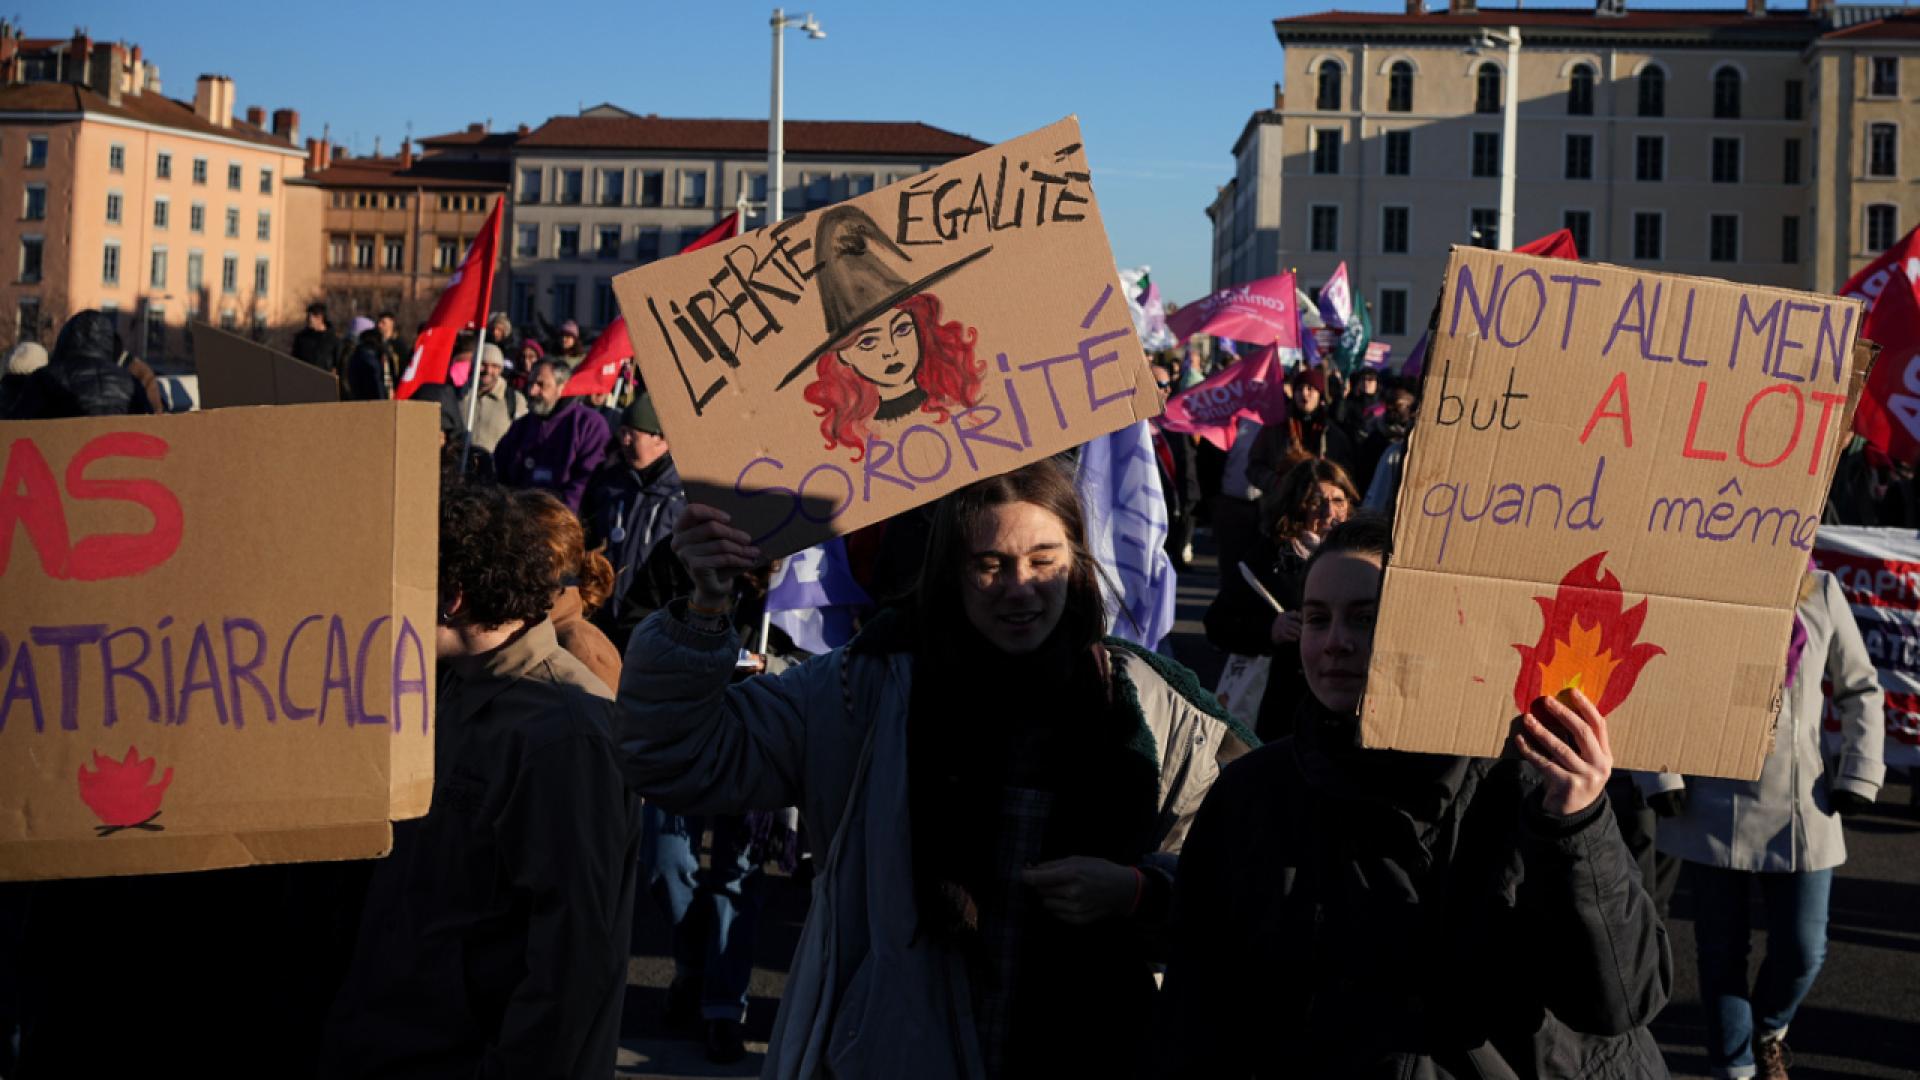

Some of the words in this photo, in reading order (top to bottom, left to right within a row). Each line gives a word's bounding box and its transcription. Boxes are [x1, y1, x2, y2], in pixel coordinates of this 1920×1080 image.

[1450, 263, 1601, 350] NOT
[1602, 278, 1708, 368] ALL
[1728, 293, 1853, 384] MEN
[1436, 359, 1529, 431] but
[1579, 371, 1633, 448] A
[1683, 380, 1848, 476] LOT
[1421, 456, 1605, 565] quand
[1647, 477, 1819, 551] même
